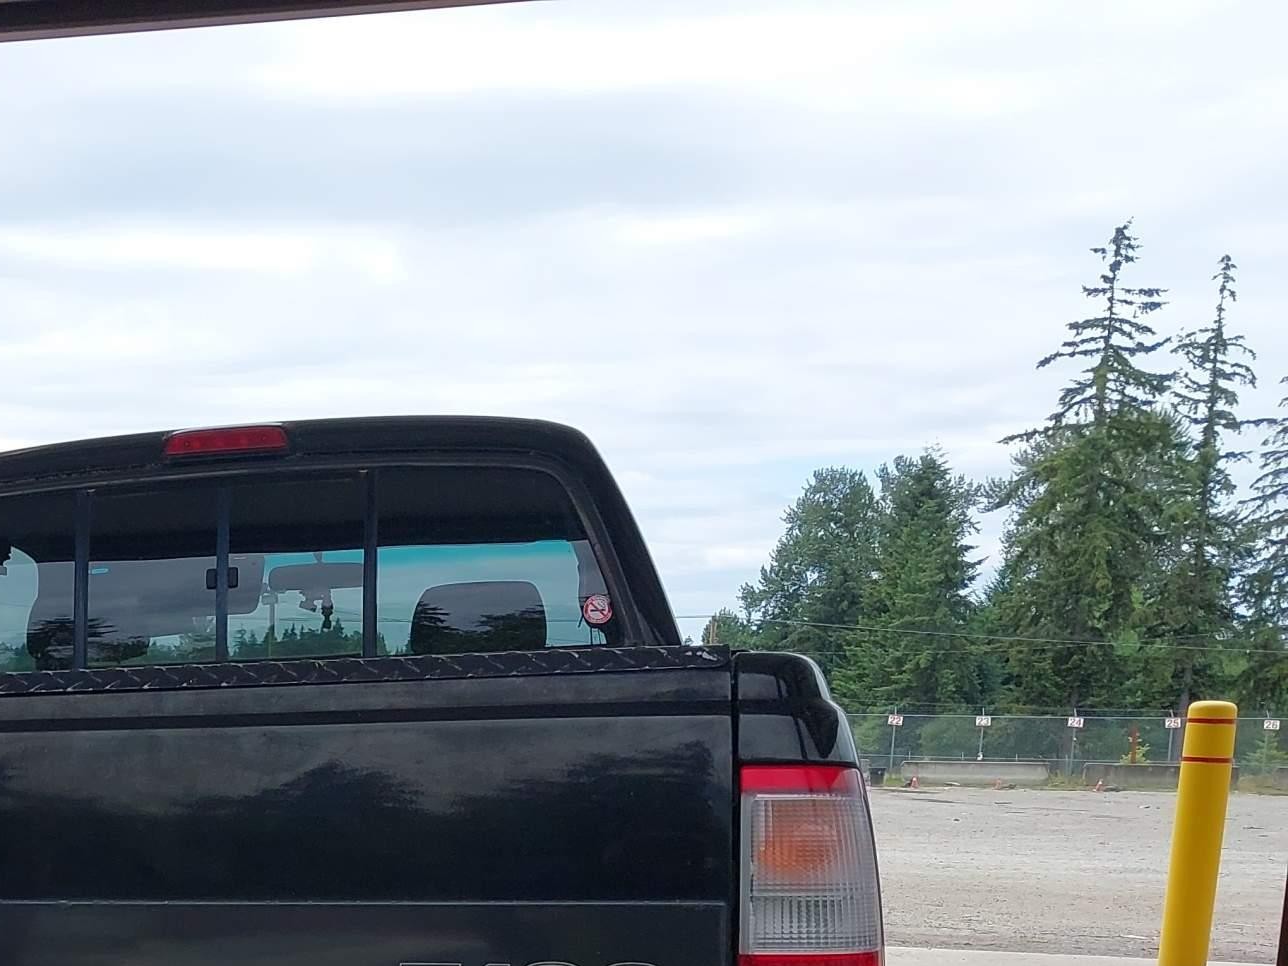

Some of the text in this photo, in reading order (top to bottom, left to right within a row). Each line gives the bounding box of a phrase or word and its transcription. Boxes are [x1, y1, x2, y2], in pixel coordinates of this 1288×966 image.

[889, 715, 902, 725] 22
[977, 717, 990, 726] 23
[1070, 717, 1082, 727] 24
[1166, 719, 1179, 728] 25
